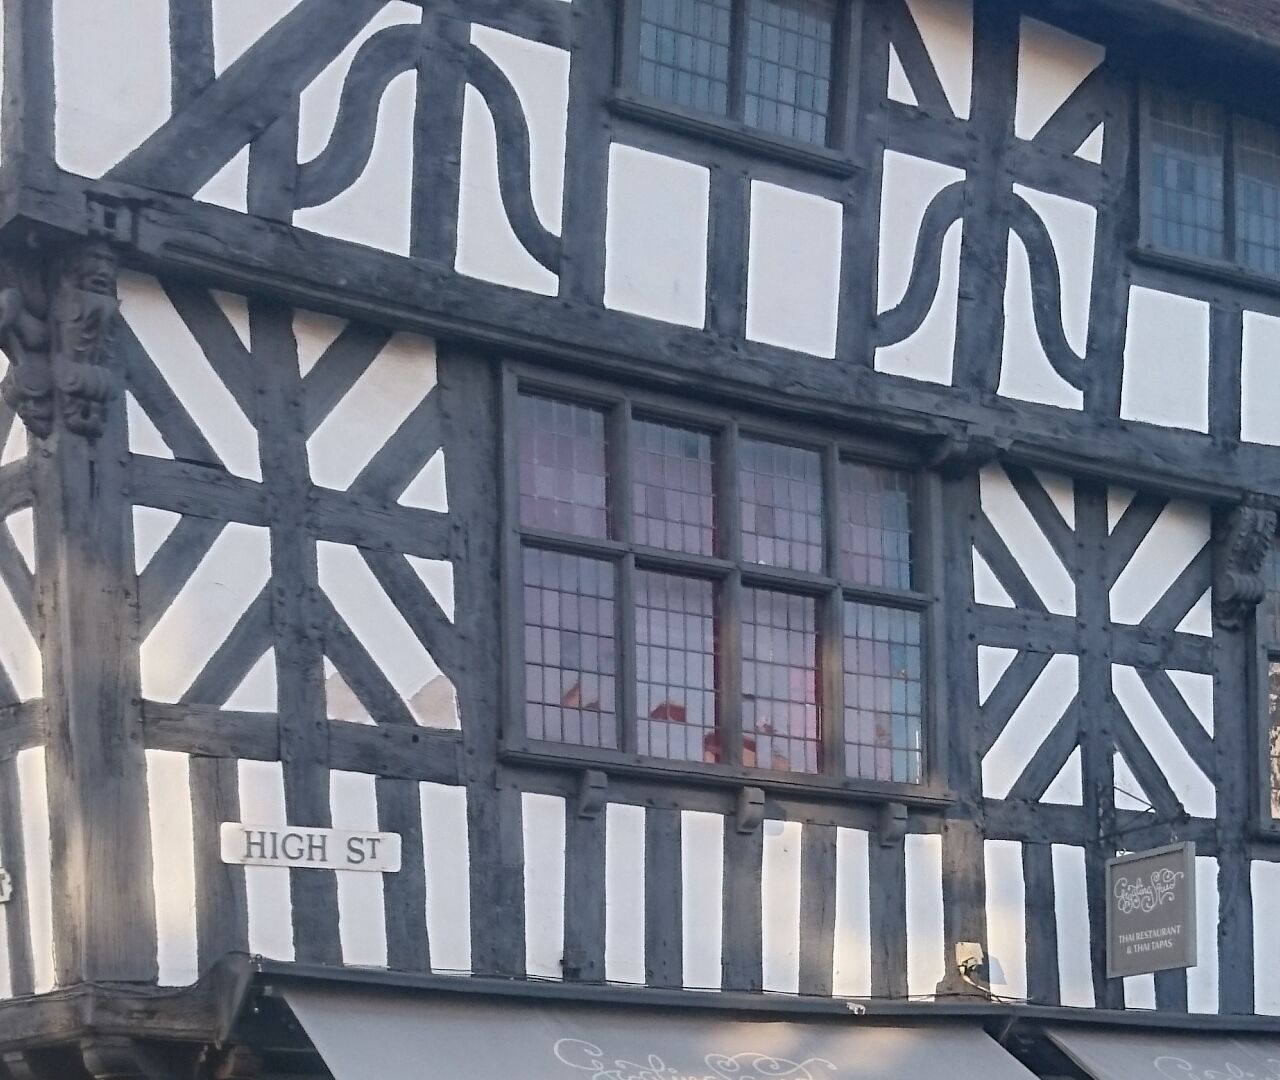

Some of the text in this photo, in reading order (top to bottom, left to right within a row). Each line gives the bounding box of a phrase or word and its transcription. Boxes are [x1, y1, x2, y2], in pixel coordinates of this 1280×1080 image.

[244, 830, 381, 865] HIGH ST
[1119, 925, 1182, 944] THAI RESTAURANT
